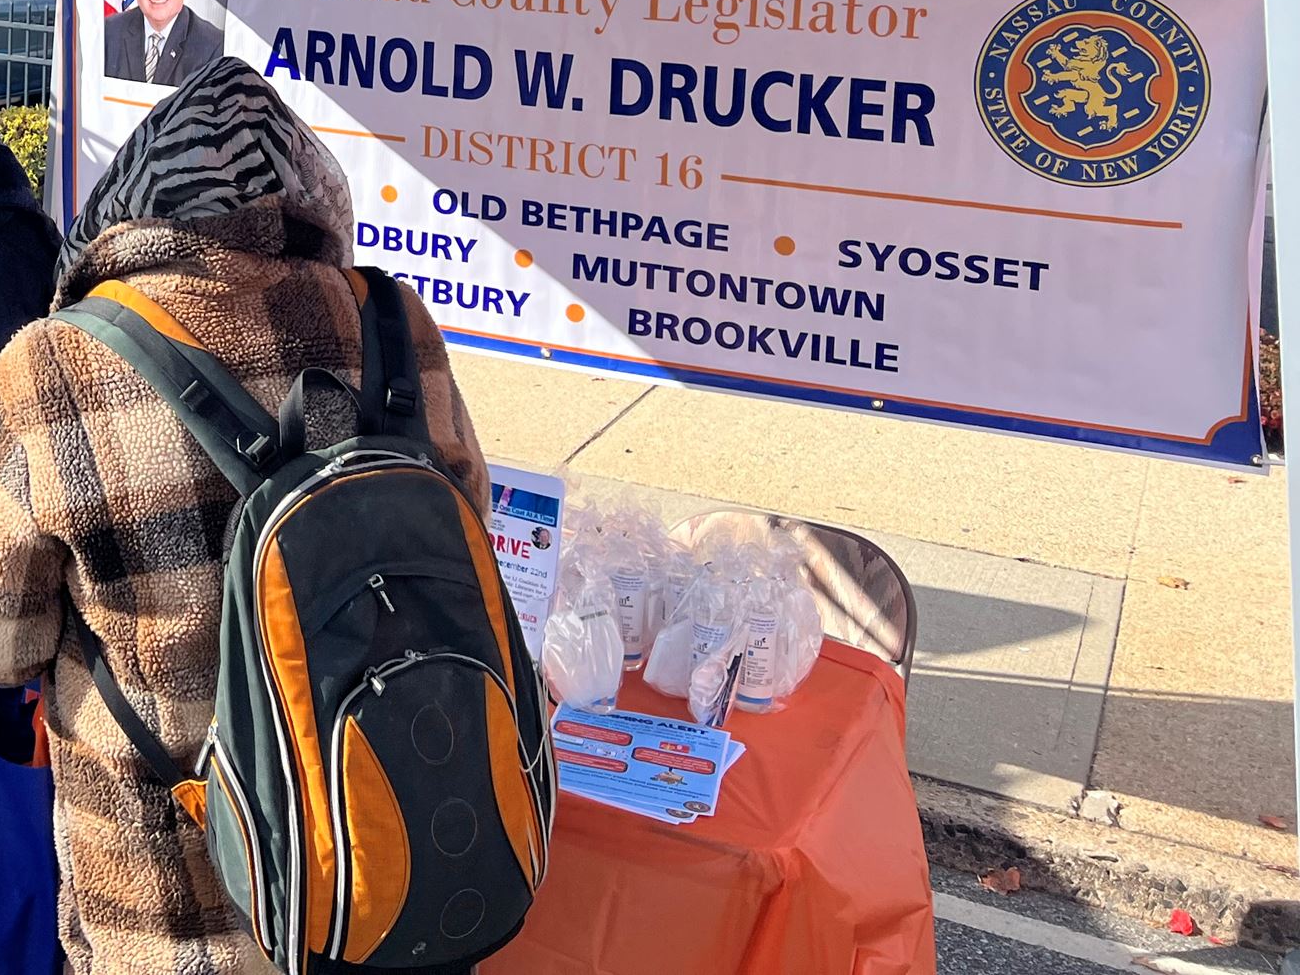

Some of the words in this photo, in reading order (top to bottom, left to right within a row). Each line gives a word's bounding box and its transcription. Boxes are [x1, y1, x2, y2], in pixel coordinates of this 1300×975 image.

[264, 26, 493, 100] ARNOLD
[514, 49, 583, 112] W.
[609, 57, 936, 147] DRUCKER
[420, 124, 637, 182] DISTRICT
[655, 152, 703, 191] 16
[985, 87, 1031, 154] STATE
[1035, 151, 1069, 175] OF
[1081, 155, 1139, 181] NEW
[1146, 101, 1199, 161] YORK
[357, 221, 479, 264] DBURY
[572, 252, 886, 322] MUTTONTOWN
[432, 187, 508, 222] OLD
[521, 198, 730, 252] BETHPAGE
[838, 239, 1050, 292] SYOSSET
[628, 307, 900, 373] BROOKVILLE
[498, 559, 528, 573] ecember
